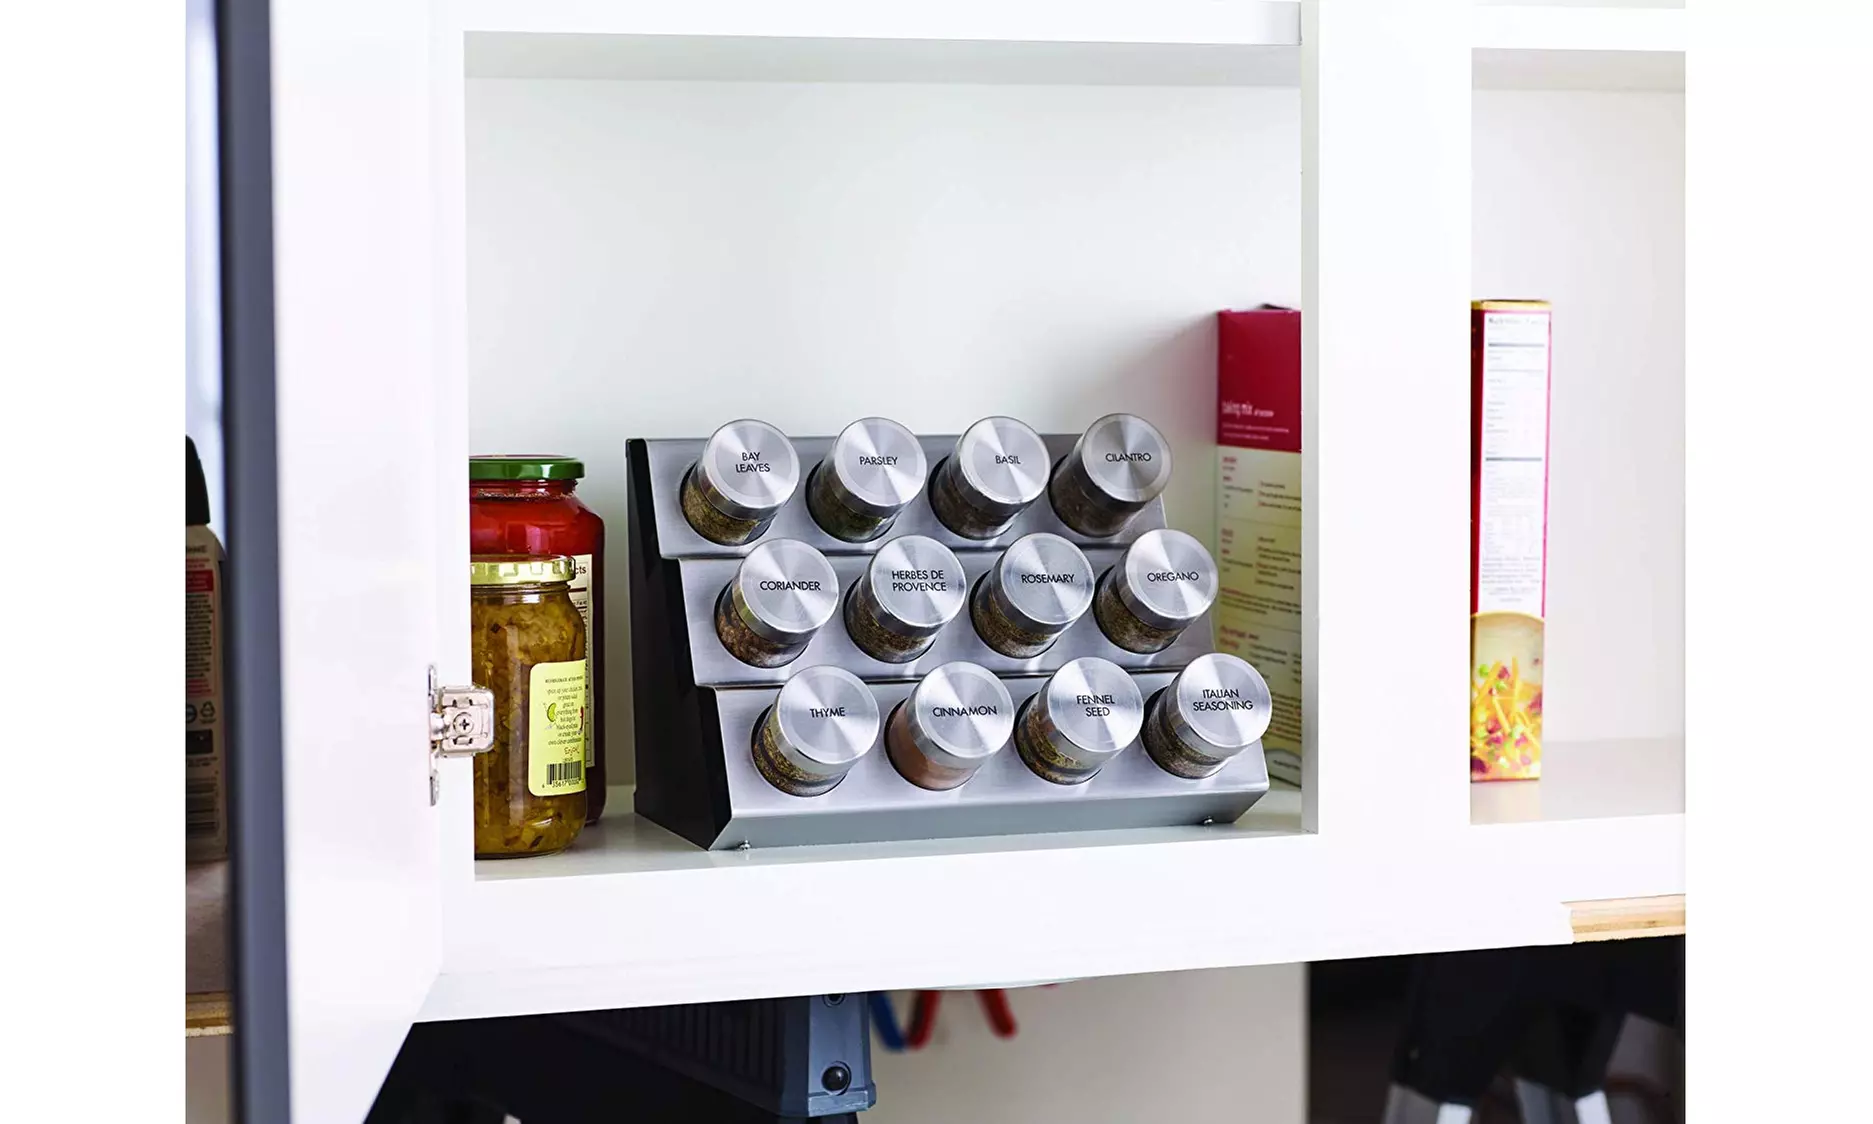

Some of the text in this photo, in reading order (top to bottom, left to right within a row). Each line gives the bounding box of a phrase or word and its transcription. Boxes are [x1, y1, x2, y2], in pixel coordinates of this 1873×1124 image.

[742, 452, 760, 461] BAY
[859, 455, 898, 466] PARSLEY
[995, 454, 1021, 465] BASIL
[1105, 452, 1151, 462] CILANTRO
[736, 463, 770, 473] LEAVES
[575, 566, 587, 575] cts
[891, 569, 944, 581] HERBES DE
[1021, 573, 1075, 585] ROSEMARY
[1147, 571, 1200, 582] OREGANO
[759, 580, 821, 592] CORIANDER
[892, 581, 947, 592] PROVENCE
[1202, 688, 1240, 699] ITALIAN
[1076, 694, 1115, 705] FENNEL
[1192, 699, 1254, 711] SEASONING
[809, 706, 846, 718] THYME
[932, 705, 997, 718] CINNAMON
[1085, 705, 1110, 717] SEED
